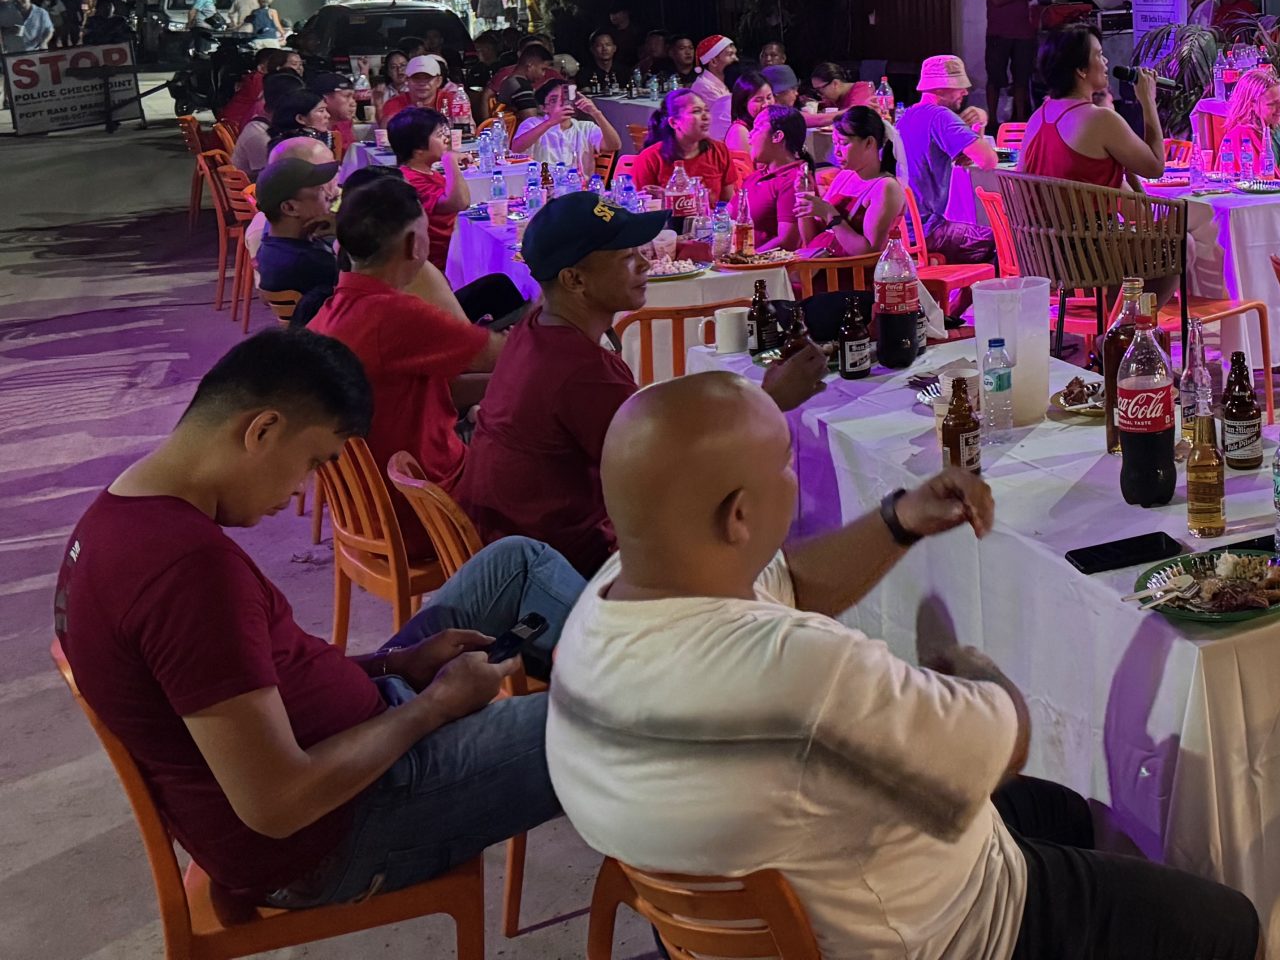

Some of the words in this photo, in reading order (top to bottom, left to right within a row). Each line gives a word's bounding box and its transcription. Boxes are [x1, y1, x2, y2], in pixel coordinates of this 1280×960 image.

[12, 47, 128, 90] STOP
[14, 89, 57, 102] POLICE
[1118, 391, 1167, 419] ca-Cola
